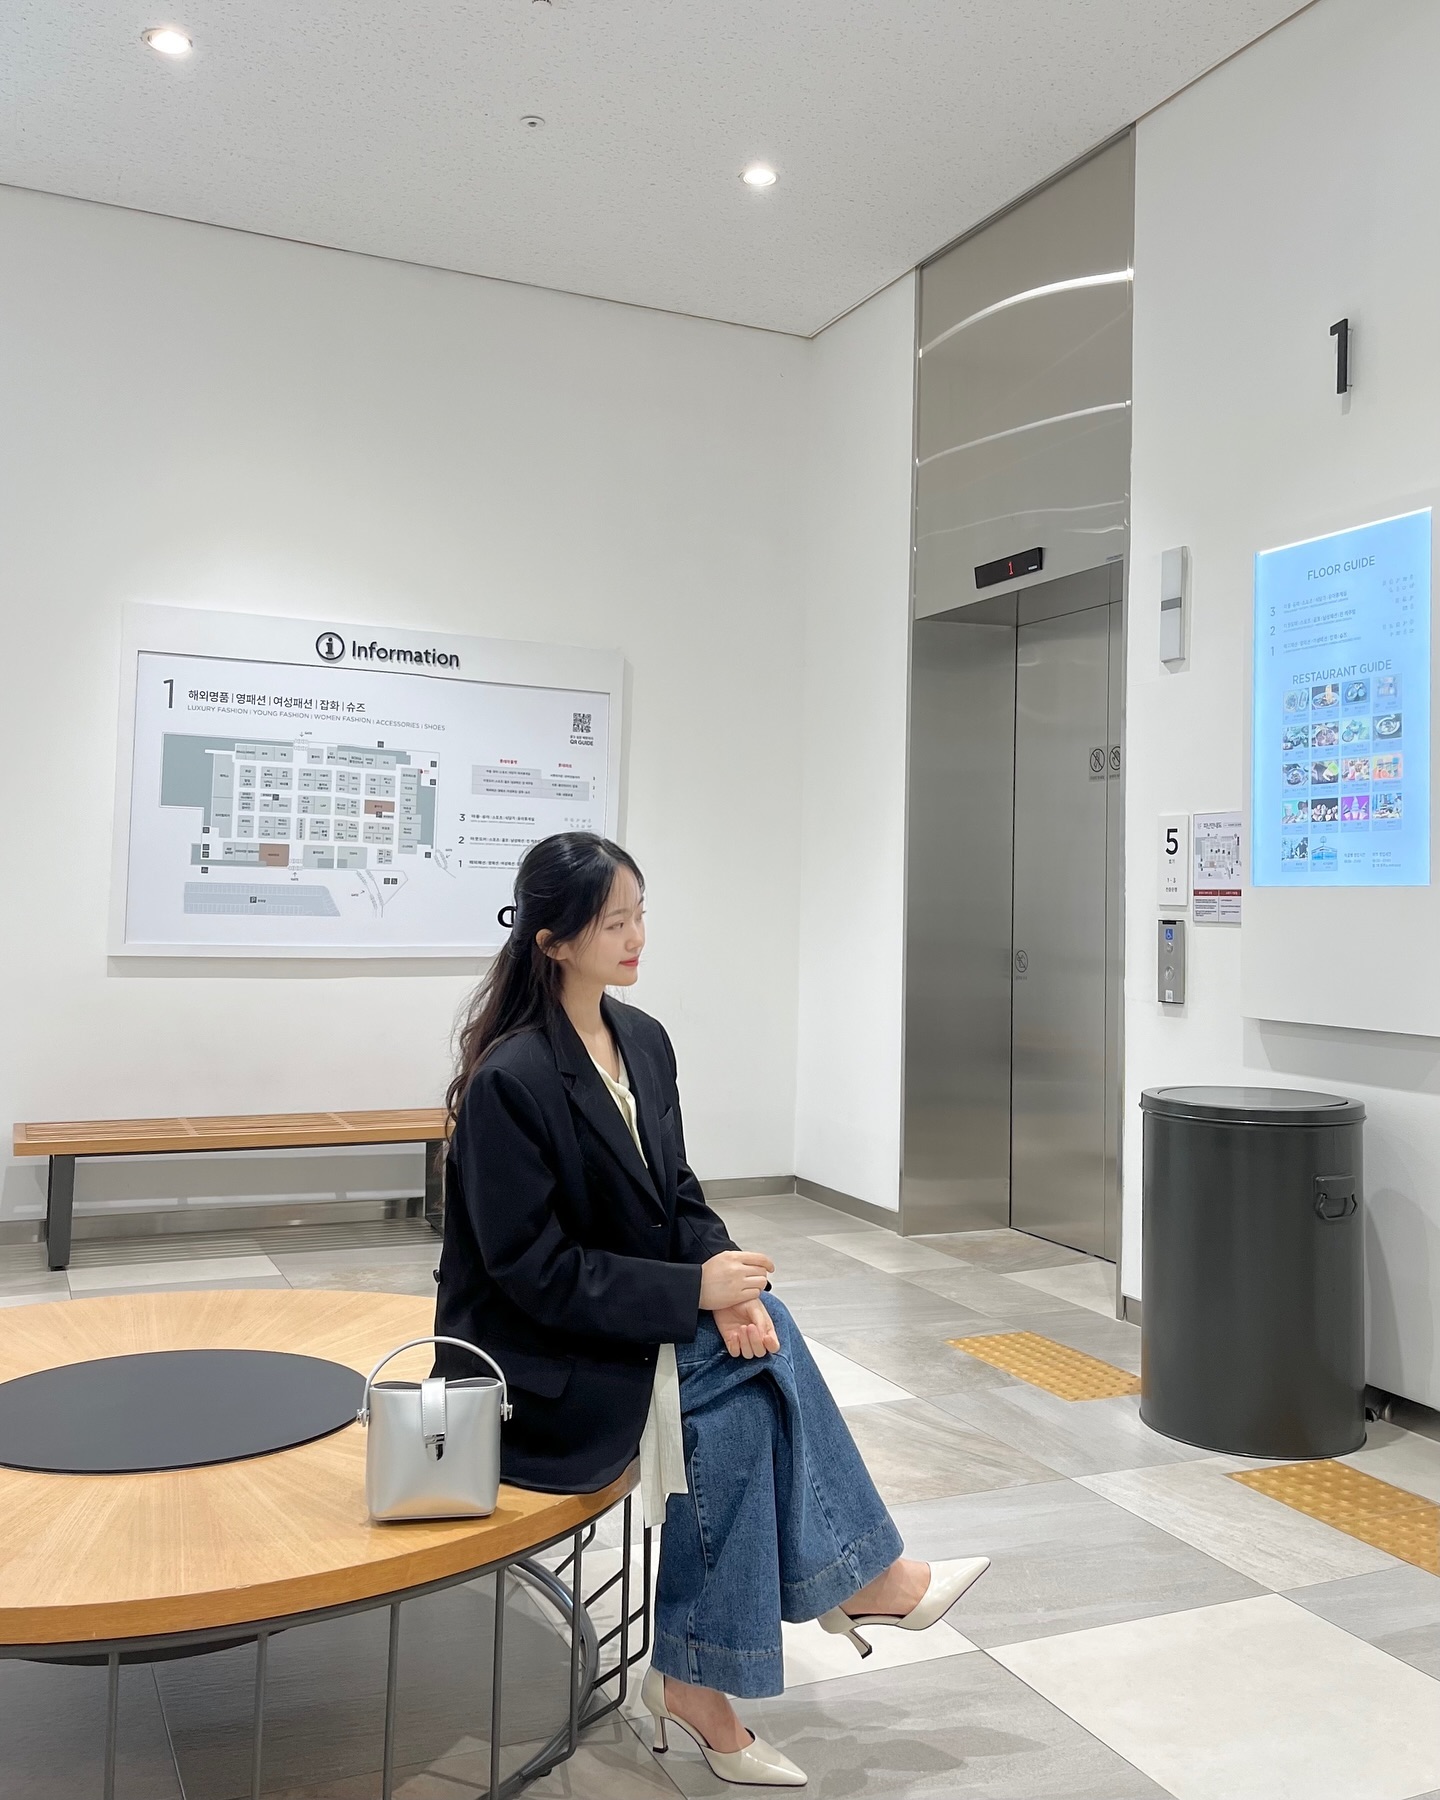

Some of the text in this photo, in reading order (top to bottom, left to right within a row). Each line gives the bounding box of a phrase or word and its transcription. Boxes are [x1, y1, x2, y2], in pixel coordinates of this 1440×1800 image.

[1330, 318, 1348, 394] 1
[1008, 561, 1014, 576] 1
[1307, 555, 1376, 580] FLOOR GUIDE
[1270, 606, 1276, 617] 3
[1270, 626, 1276, 636] 2
[351, 640, 460, 668] Information
[1271, 646, 1275, 656] 1
[1292, 659, 1392, 685] RESTAURANT GUIDE
[163, 678, 174, 709] 1
[188, 690, 366, 713] 해외명품 영패션 여성패션 잡화 슈즈
[217, 707, 248, 715] FASHION
[253, 709, 278, 717] YOUNG
[279, 711, 309, 719] FASHION
[314, 713, 341, 721] WOMEN
[342, 715, 371, 724] FASHION
[376, 719, 420, 729] ACCESSORIES
[424, 723, 446, 731] SHOES
[459, 813, 466, 822] 3
[458, 836, 465, 844] 2
[1165, 828, 1178, 855] 5
[458, 860, 463, 868] 1
